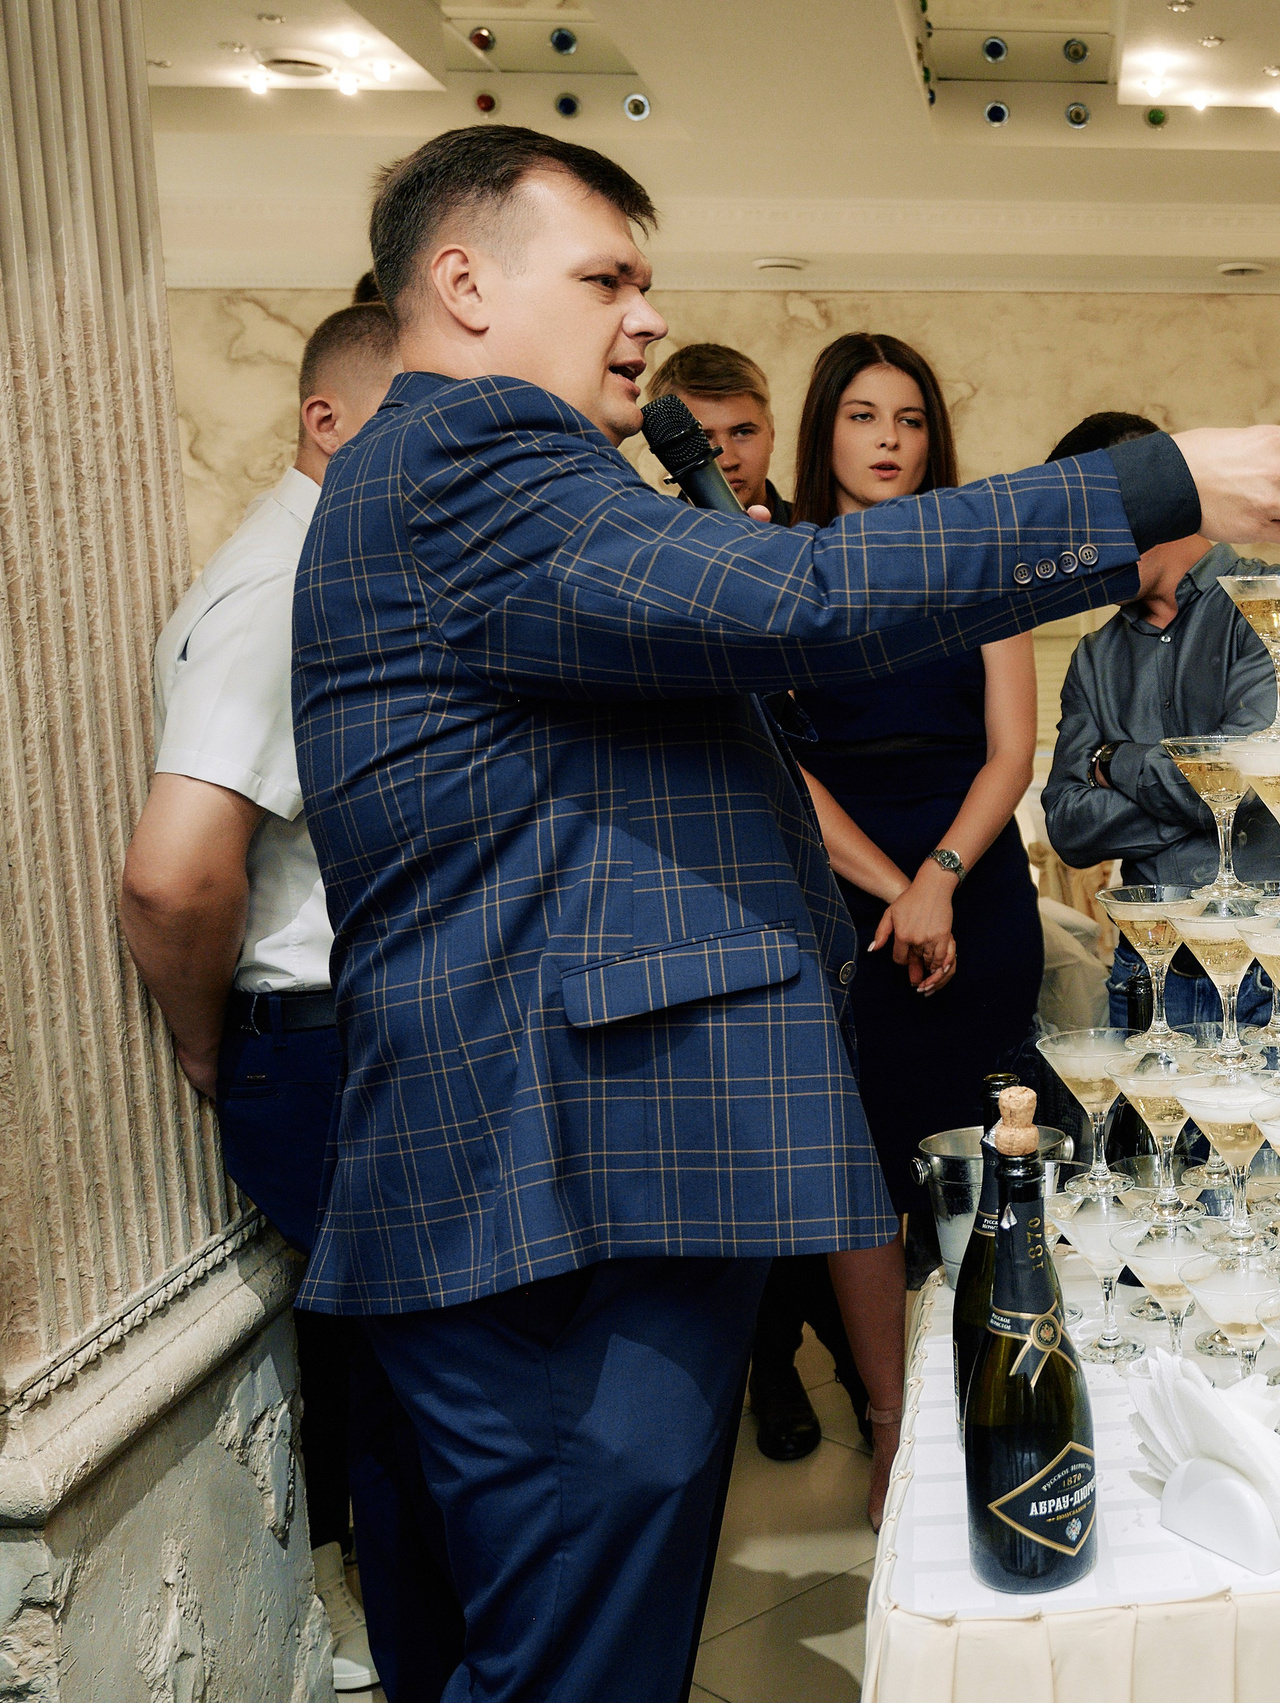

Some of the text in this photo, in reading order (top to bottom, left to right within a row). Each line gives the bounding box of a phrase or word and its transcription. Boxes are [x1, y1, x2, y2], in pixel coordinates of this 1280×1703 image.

[1027, 1217, 1044, 1271] 1870
[1041, 1466, 1070, 1492] РУССКОЕ
[1062, 1472, 1082, 1488] 1870
